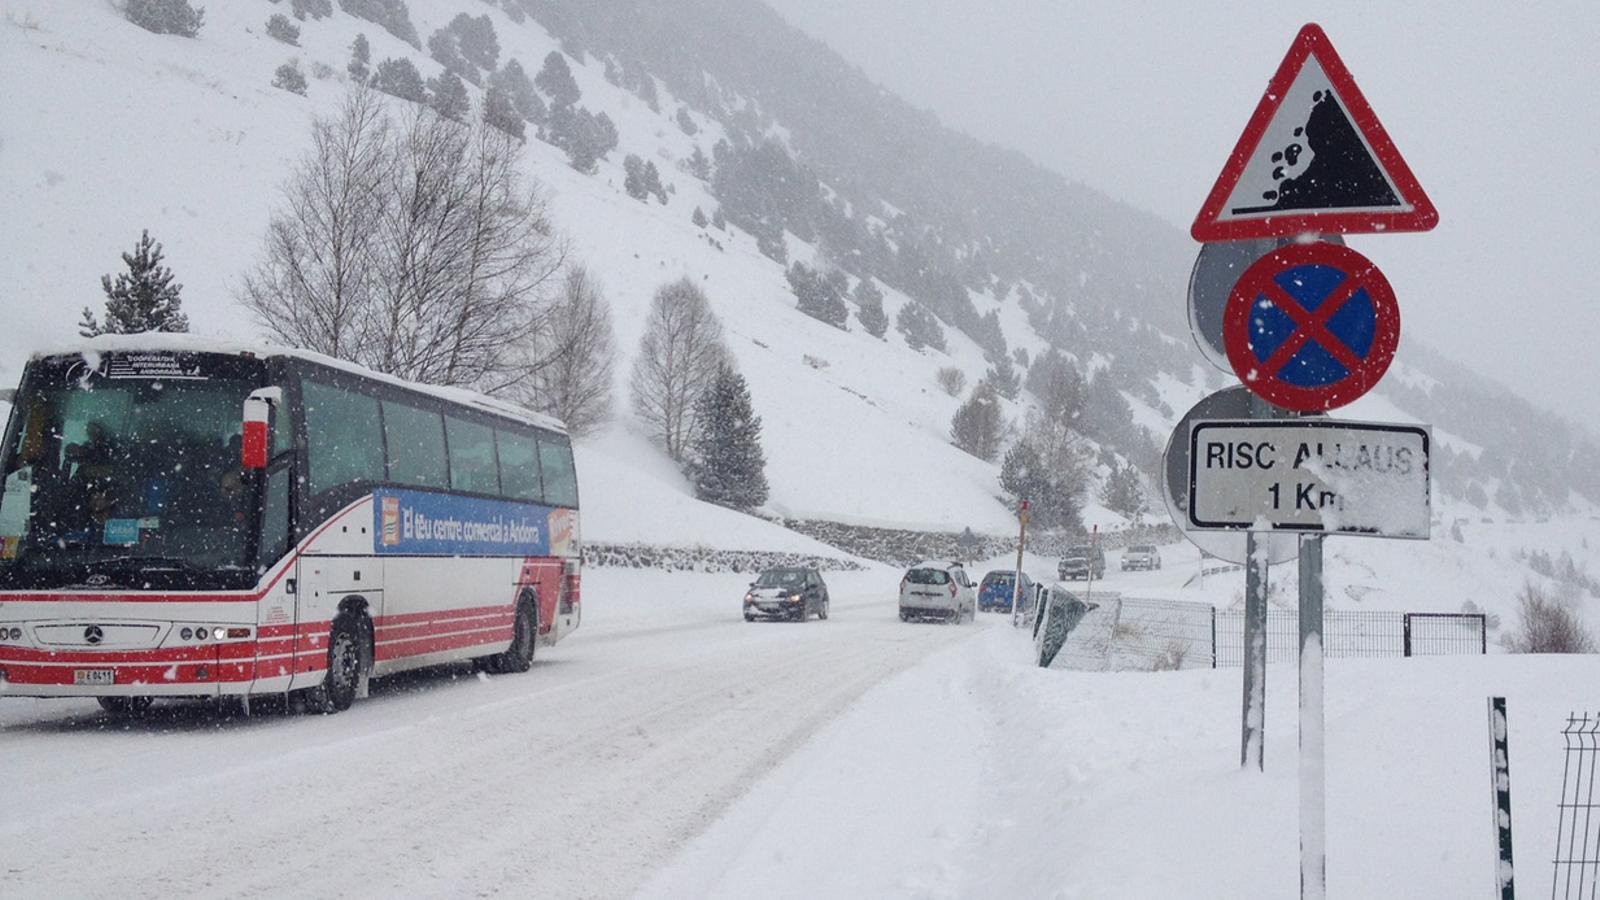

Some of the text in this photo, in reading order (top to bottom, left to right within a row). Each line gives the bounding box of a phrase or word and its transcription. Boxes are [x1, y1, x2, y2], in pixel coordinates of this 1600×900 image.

[1206, 441, 1276, 470] RISC
[1268, 482, 1344, 511] 1 Km
[403, 506, 414, 539] El
[433, 515, 463, 541] centre
[464, 514, 503, 543] comercial
[510, 517, 539, 544] Andorra
